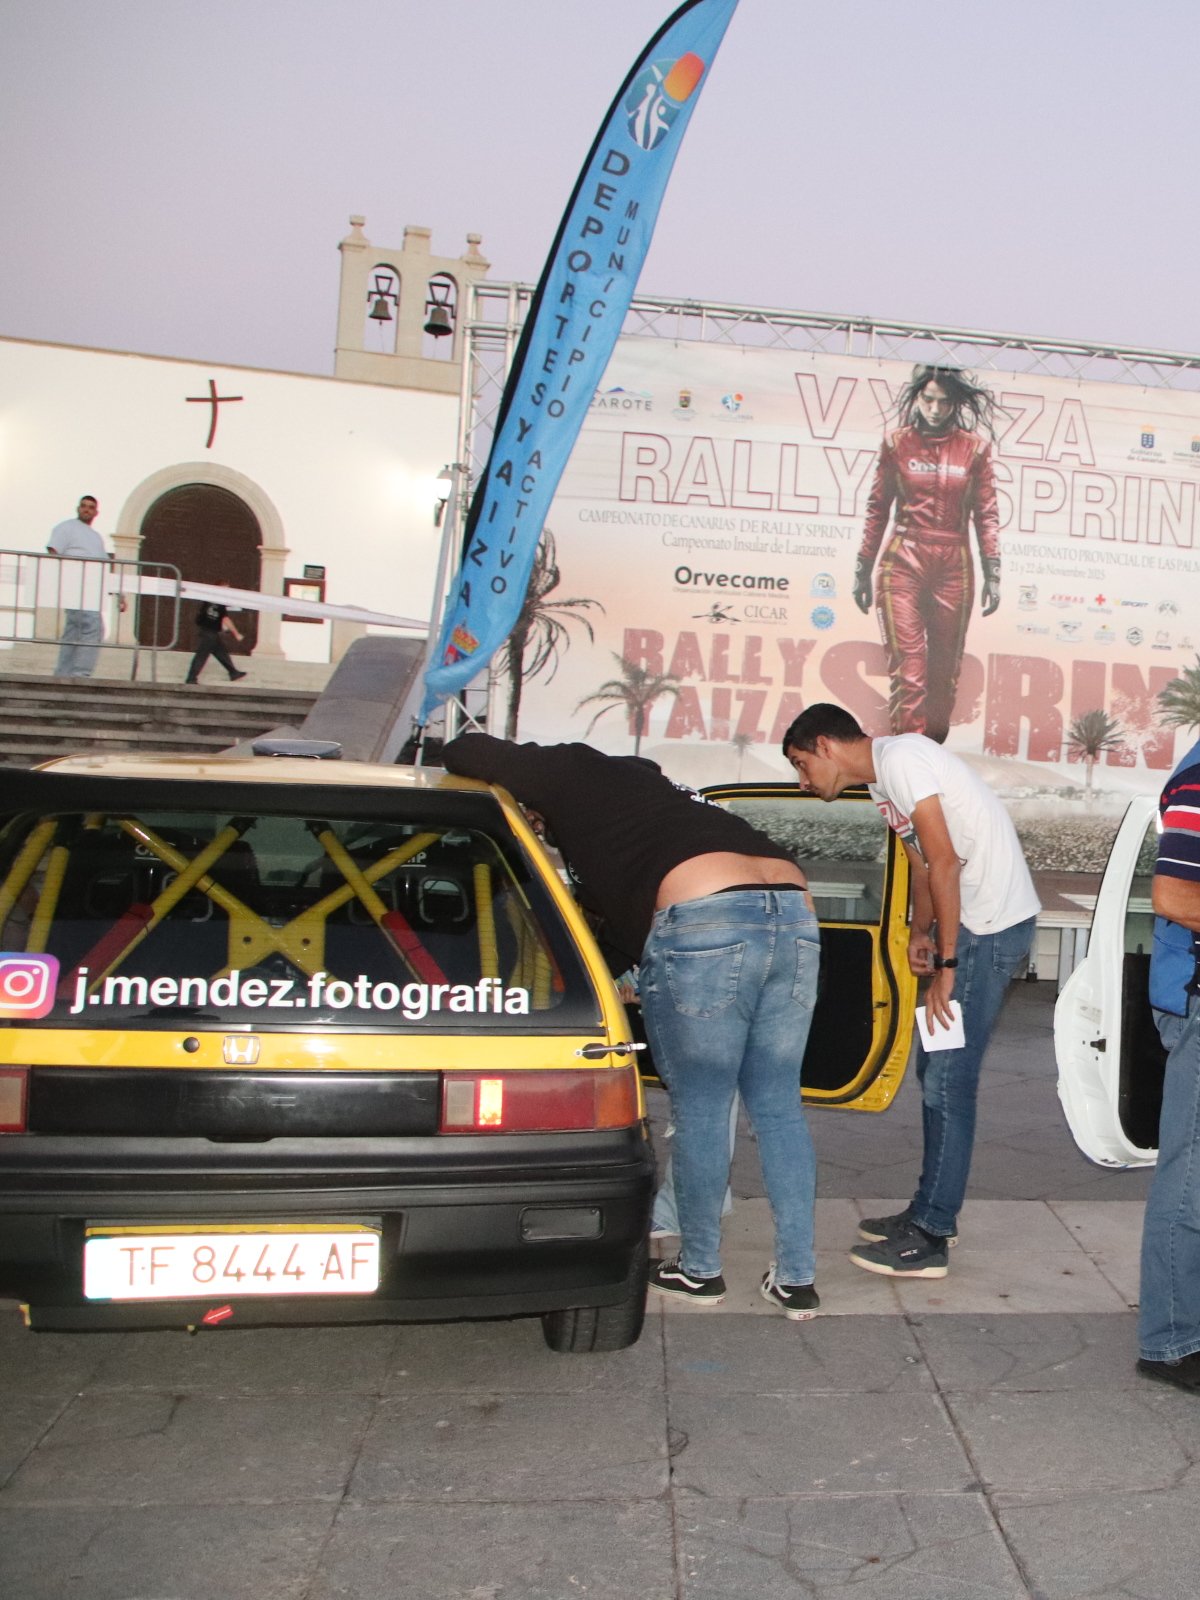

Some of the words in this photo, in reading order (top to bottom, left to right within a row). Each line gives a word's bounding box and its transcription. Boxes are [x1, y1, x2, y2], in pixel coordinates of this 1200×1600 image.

[619, 431, 878, 517] RALLY
[490, 450, 542, 595] ACTIVO
[578, 508, 661, 526] CAMPEONATO
[680, 514, 736, 531] CANARIAS
[740, 517, 759, 533] DE
[761, 519, 805, 537] RALLY
[805, 523, 855, 540] SPRINT
[662, 531, 732, 553] Campeonato
[785, 541, 837, 558] Lanzarote
[674, 566, 790, 591] Orvecame
[744, 605, 788, 620] CICAR
[623, 628, 817, 688] RALLY
[70, 967, 530, 1020] j.mendez.fotografia
[192, 1244, 305, 1284] 8444
